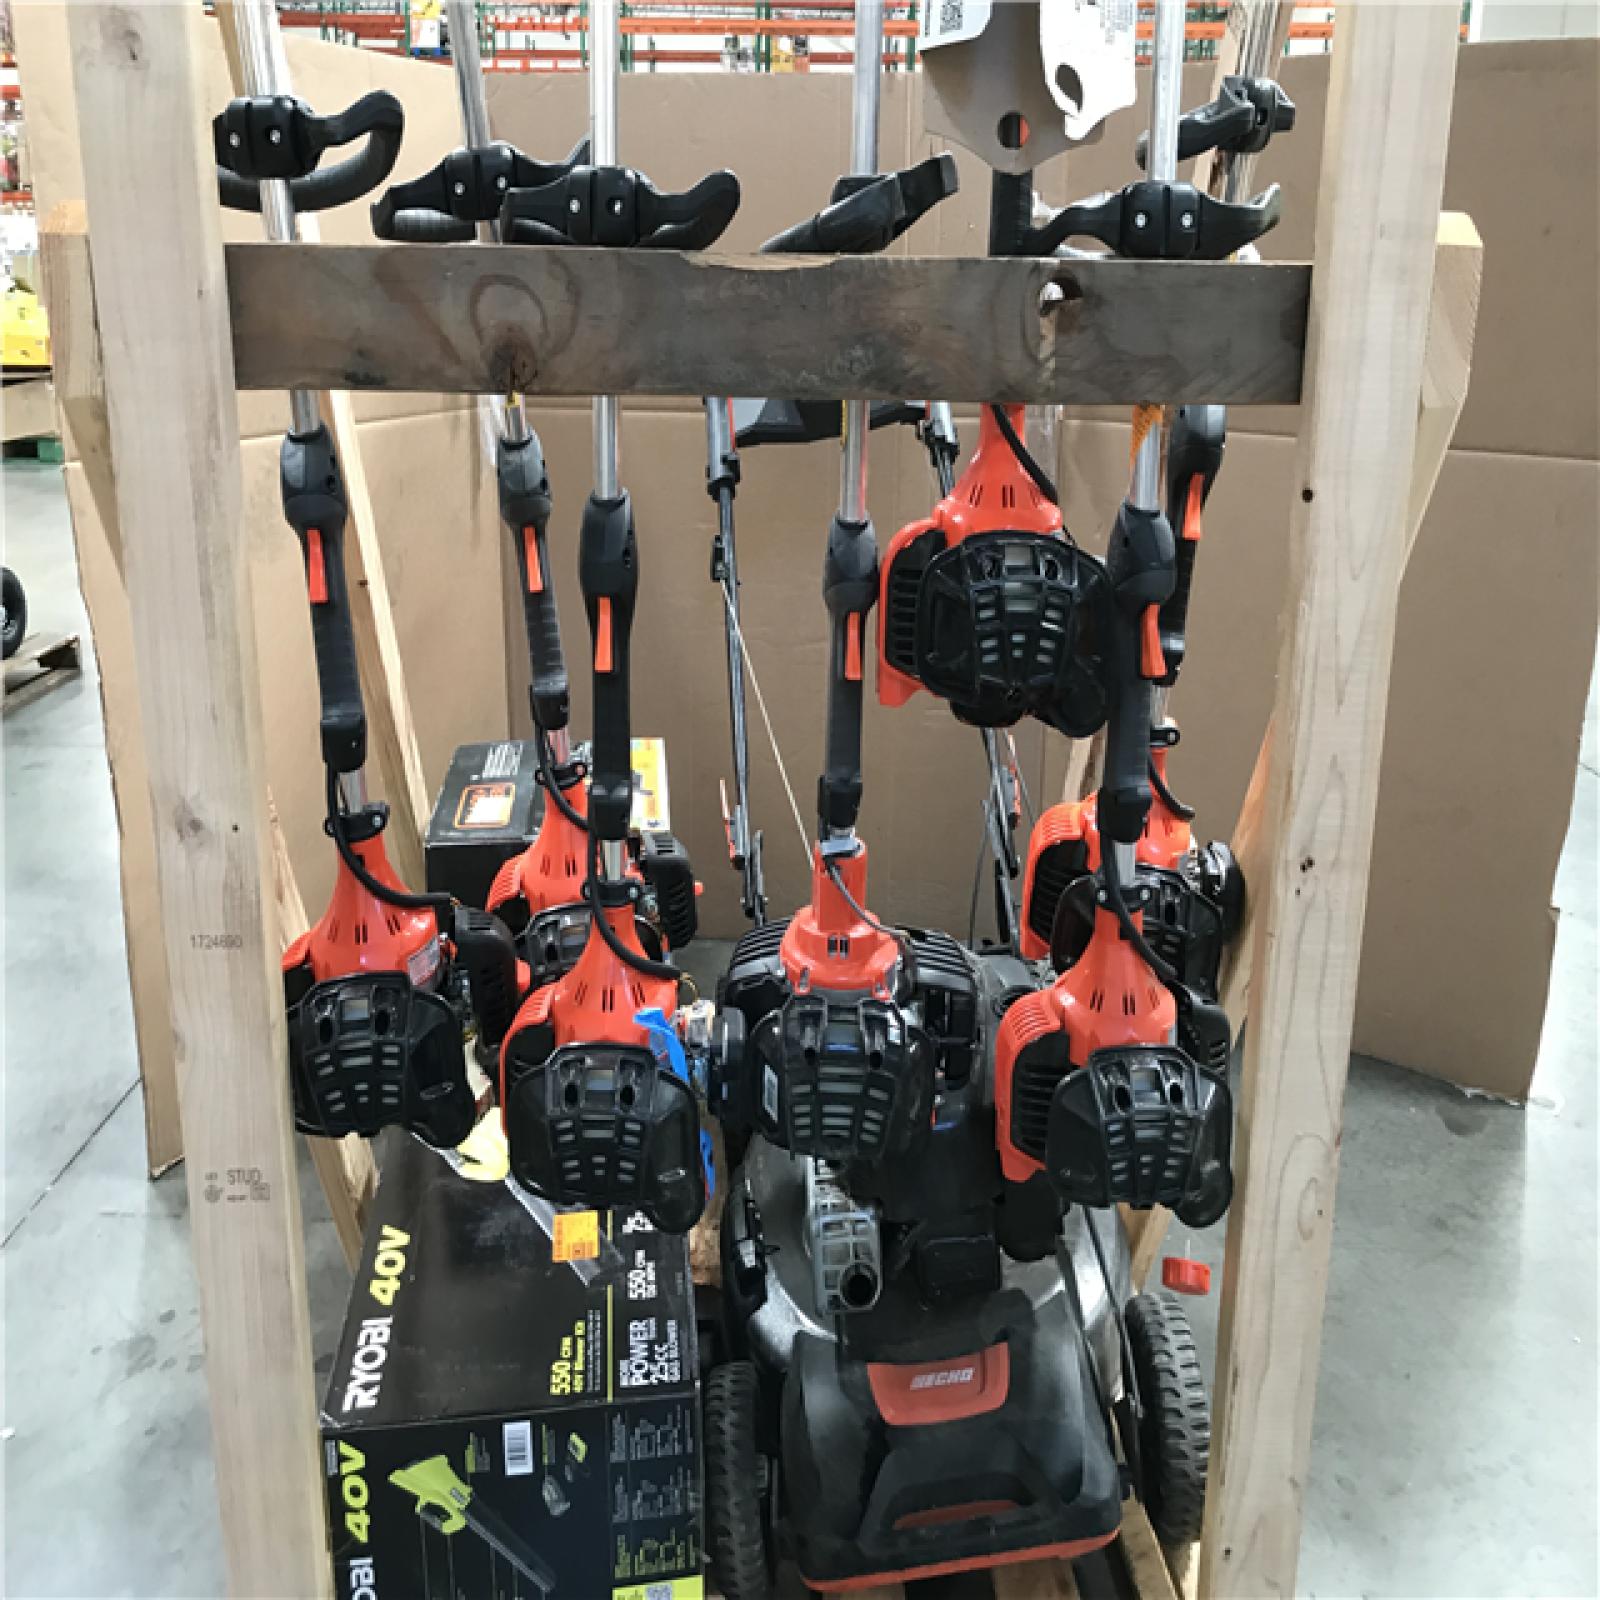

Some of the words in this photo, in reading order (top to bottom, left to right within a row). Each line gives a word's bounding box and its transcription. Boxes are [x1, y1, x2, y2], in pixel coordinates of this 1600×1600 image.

[226, 1168, 261, 1185] STUD
[342, 1315, 394, 1413] RYOBI
[369, 1224, 411, 1306] 40V
[550, 1360, 571, 1395] 550
[629, 1319, 648, 1386] POWER
[338, 1440, 370, 1543] 40V
